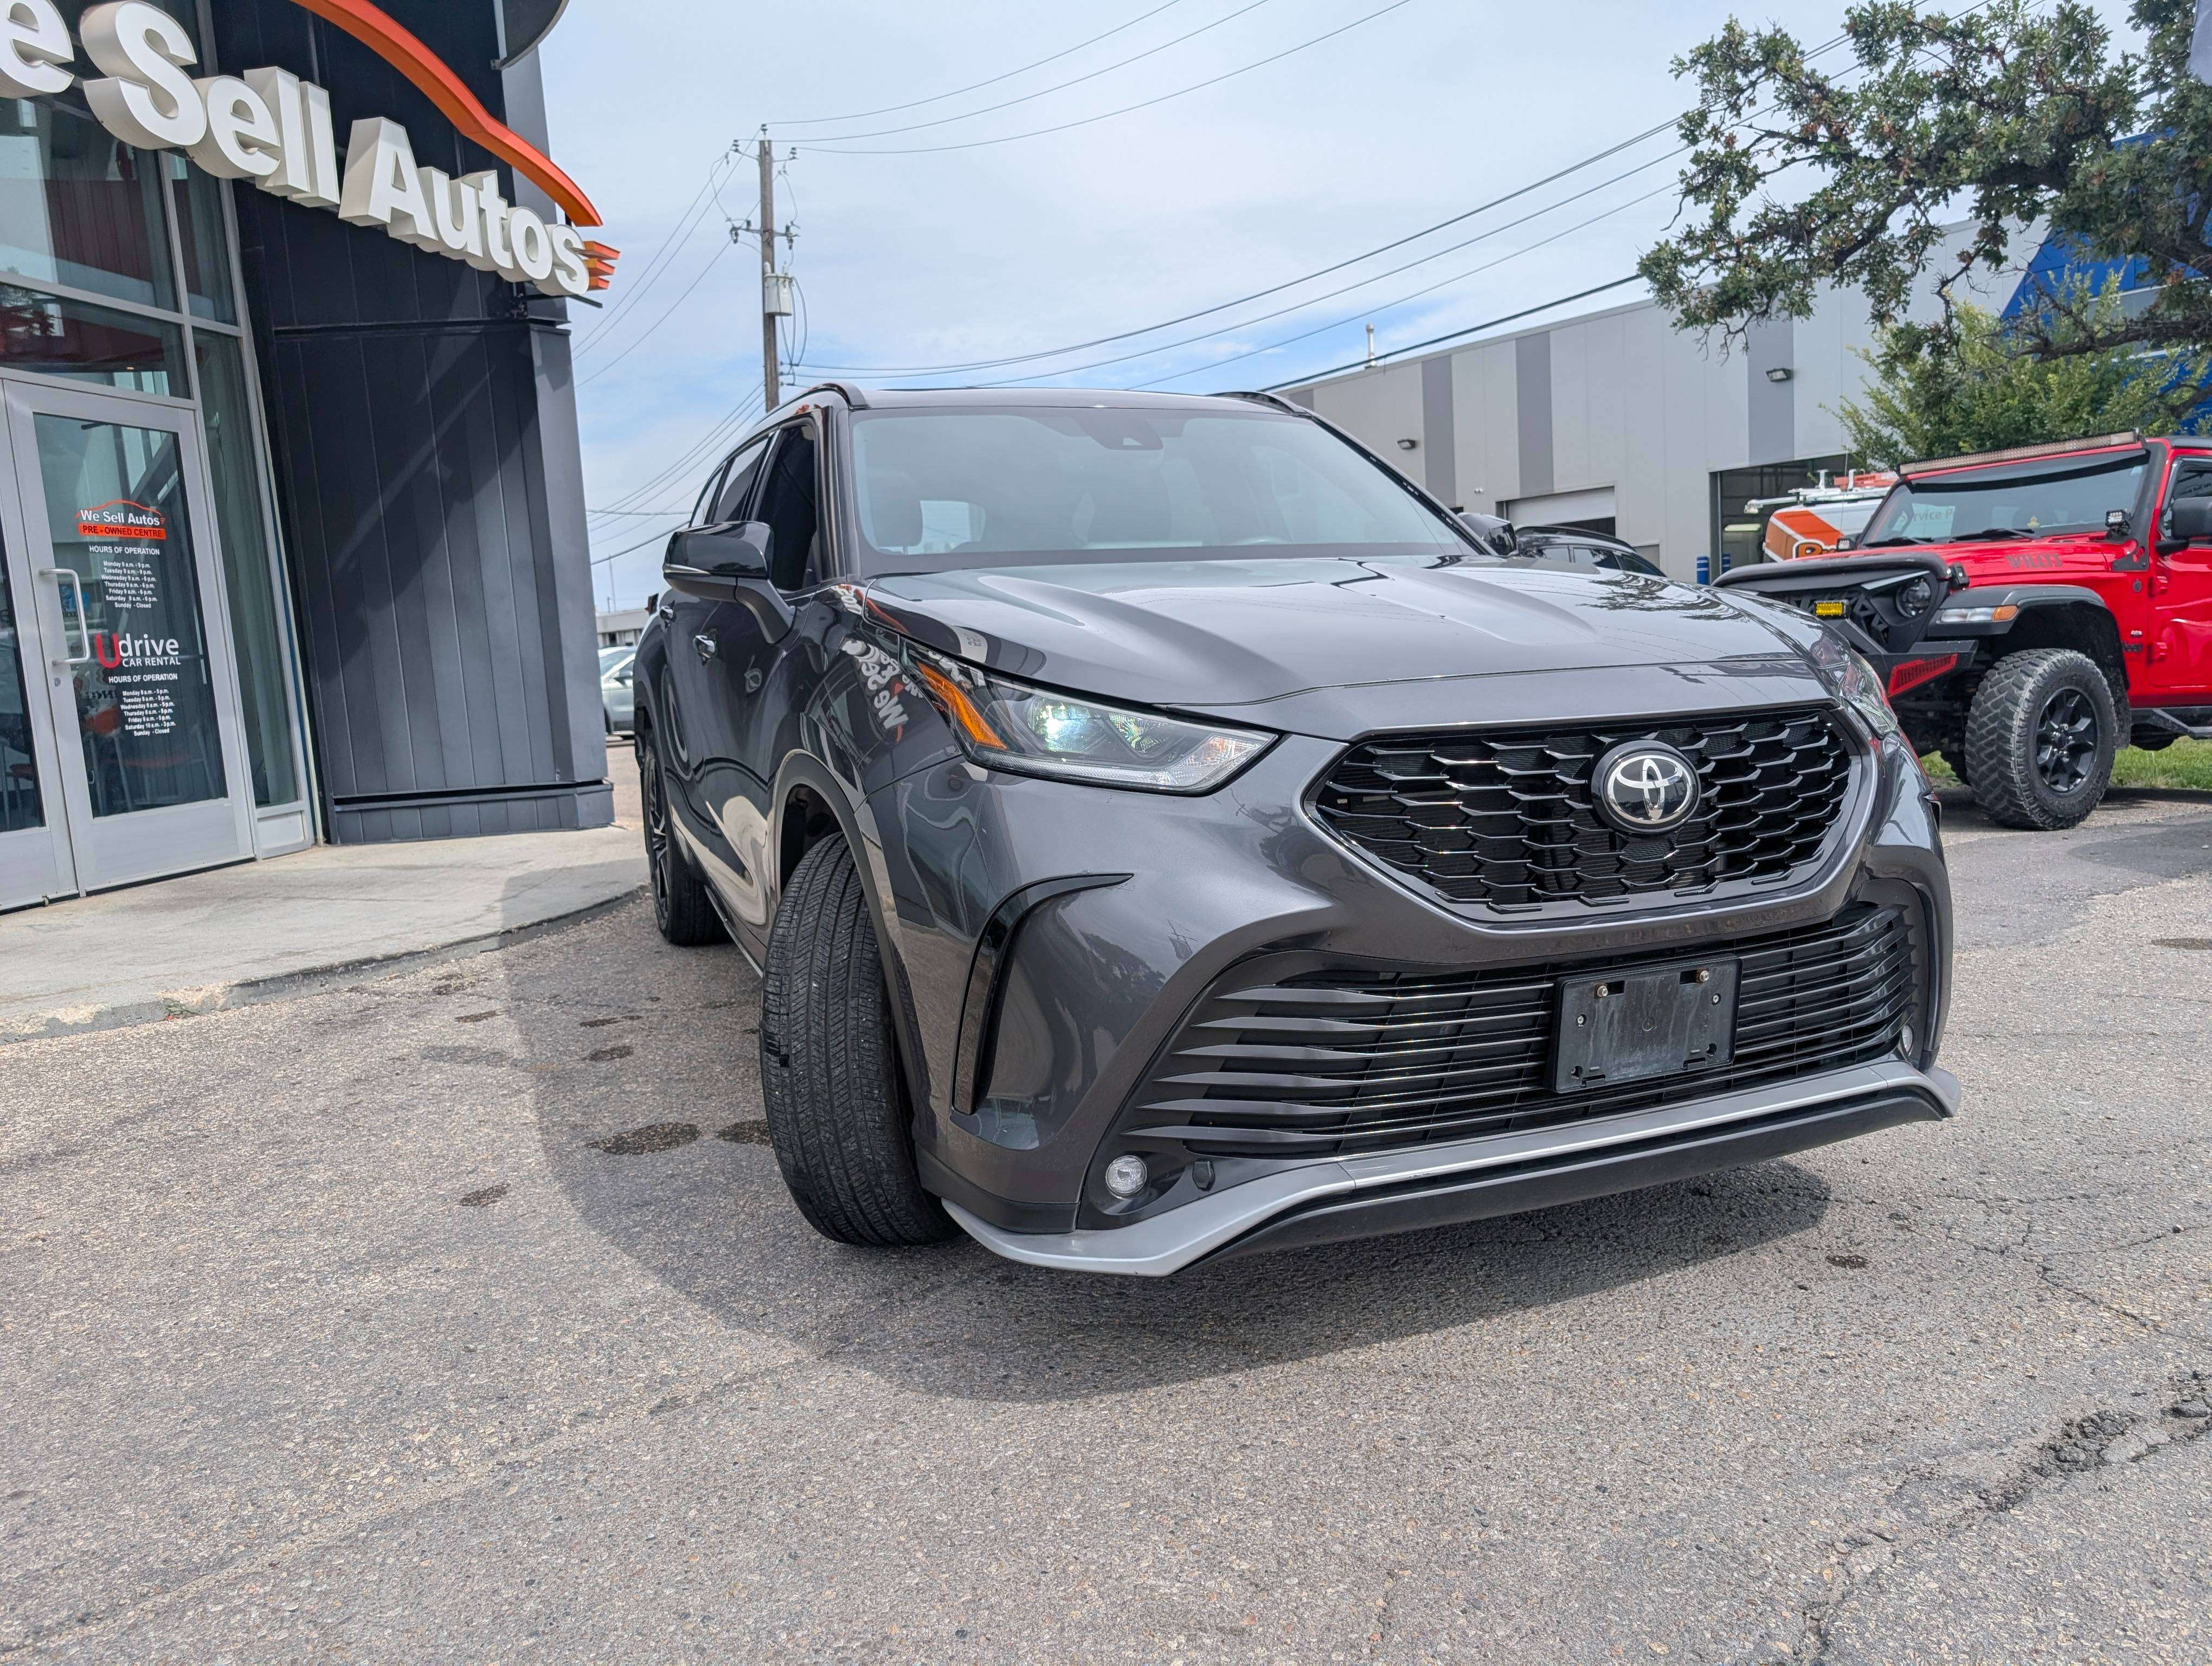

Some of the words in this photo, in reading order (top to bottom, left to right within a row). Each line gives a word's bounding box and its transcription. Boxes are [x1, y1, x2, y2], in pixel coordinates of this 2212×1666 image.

[0, 0, 75, 98] e
[81, 0, 340, 207] Sell
[339, 116, 590, 296] Autos
[80, 510, 100, 521] We
[103, 511, 124, 523] Sell
[128, 513, 159, 526] Autos
[83, 526, 98, 534] PRE
[105, 527, 132, 535] OWNED
[134, 529, 162, 537] CENTRE
[2005, 553, 2062, 568] WILLYS
[95, 633, 179, 668] Udrive
[123, 658, 142, 667] CAR
[145, 657, 181, 666] RENTAL
[143, 673, 178, 681] OPERATION
